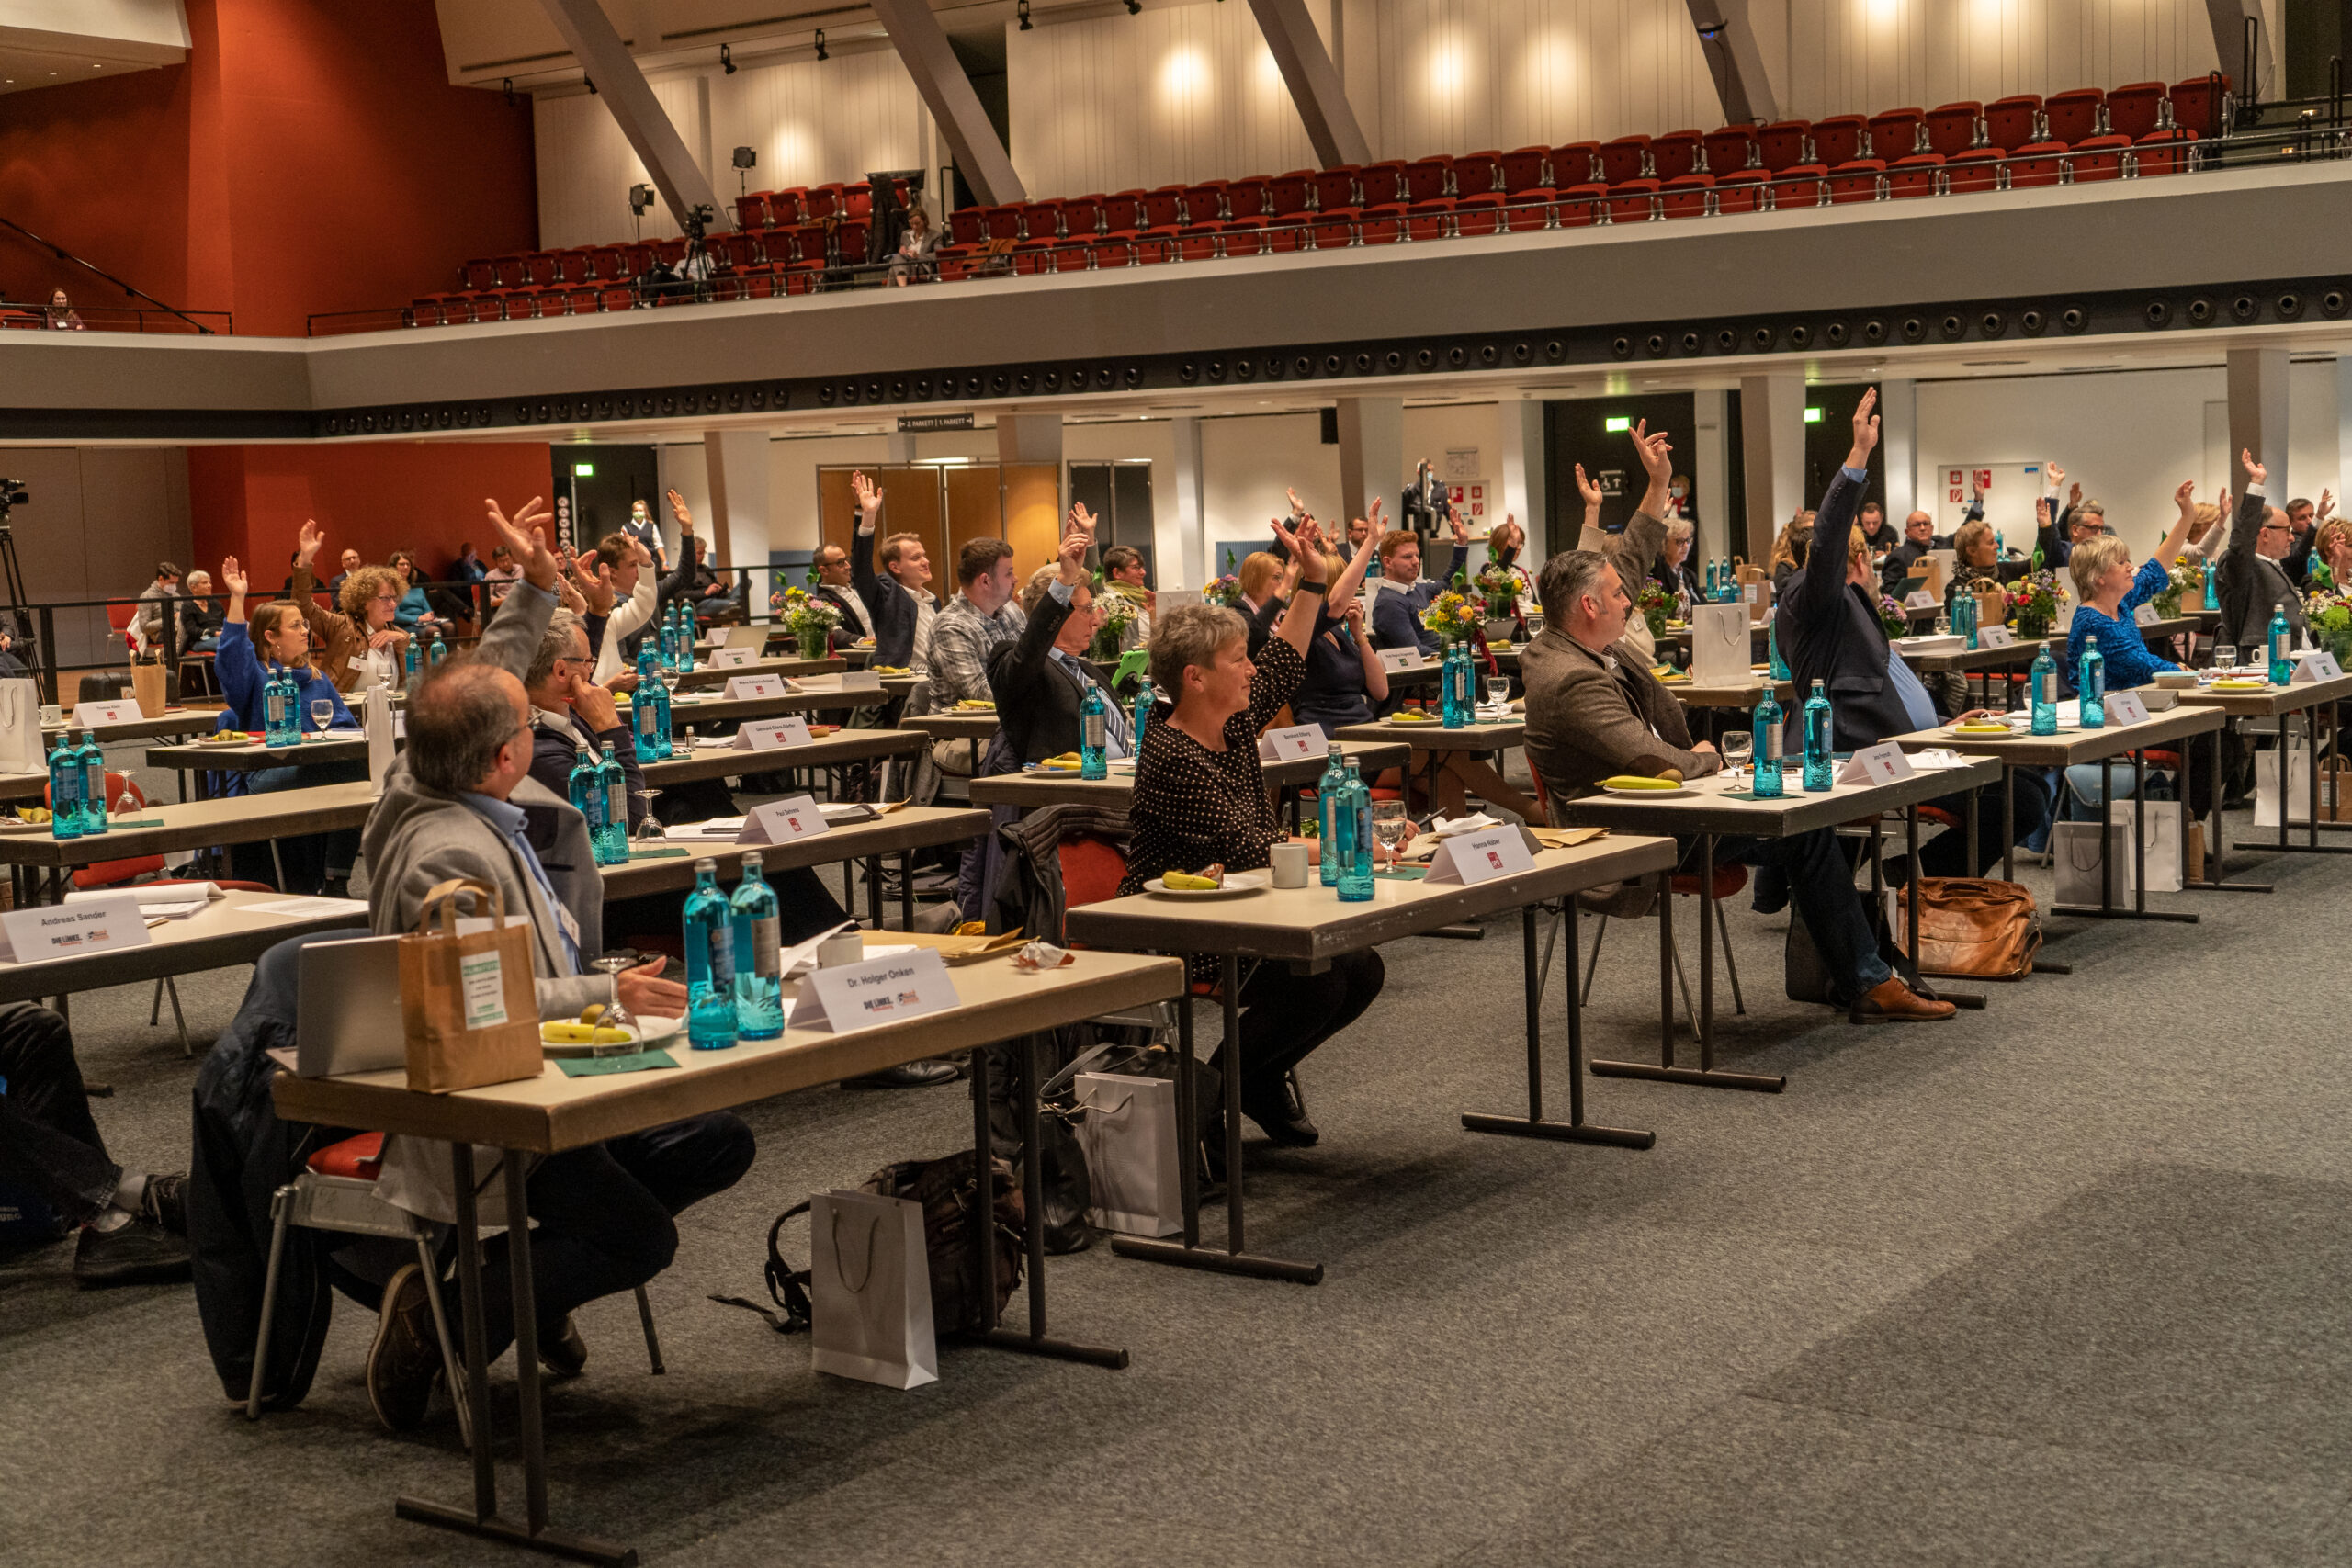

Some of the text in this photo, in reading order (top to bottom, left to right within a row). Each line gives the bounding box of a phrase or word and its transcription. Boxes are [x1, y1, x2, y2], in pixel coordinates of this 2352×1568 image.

[912, 419, 933, 427] PARKETT
[944, 417, 965, 425] PARKETT
[1471, 838, 1500, 850] Hanna Naber
[41, 911, 107, 927] Andreas Sander
[847, 967, 915, 988] Dr. Holger Onken
